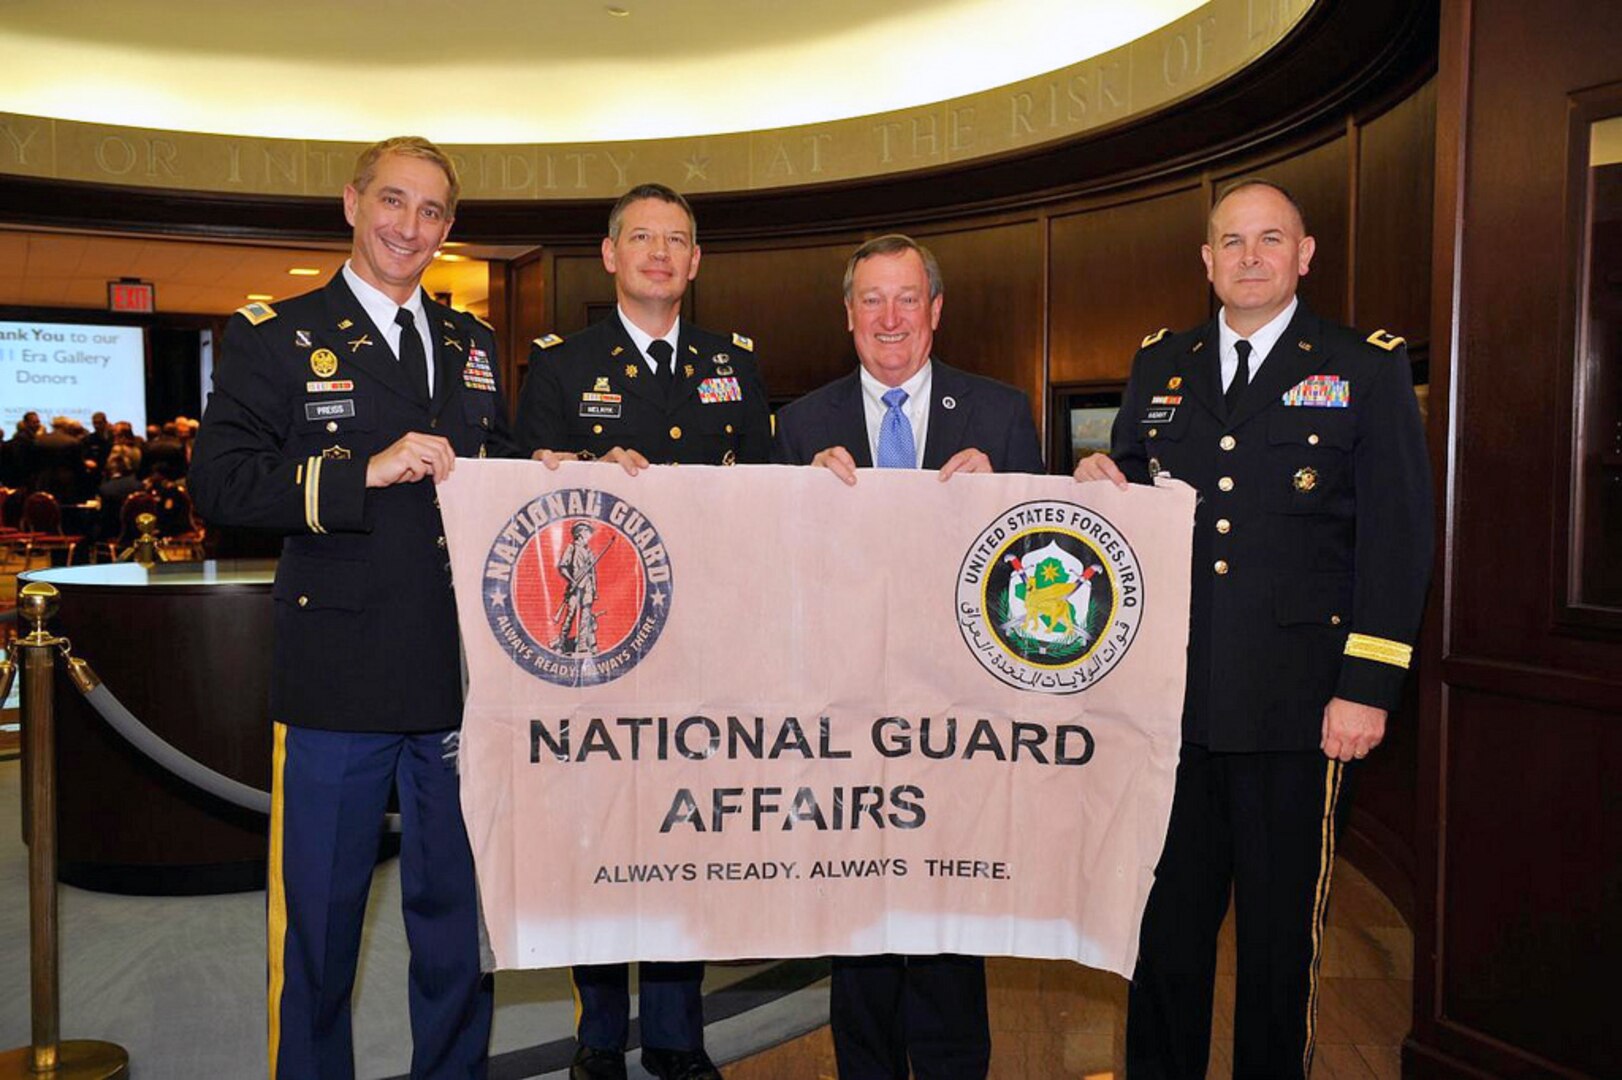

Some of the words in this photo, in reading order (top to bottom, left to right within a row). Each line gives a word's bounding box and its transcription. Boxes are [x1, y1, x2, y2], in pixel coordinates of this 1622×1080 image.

[95, 135, 180, 178] OR
[764, 133, 832, 177] AT
[873, 107, 976, 165] THE
[1009, 62, 1124, 138] RISK
[1163, 16, 1215, 87] OF
[114, 285, 148, 310] EXIT
[22, 349, 48, 363] Era
[53, 350, 111, 368] Gallery
[32, 328, 65, 342] You
[70, 332, 87, 343] to
[92, 333, 119, 344] our
[16, 369, 78, 384] Donors
[486, 491, 600, 581] NATIONAL
[609, 500, 670, 583] GUARD
[965, 528, 1005, 584] UNITED
[1007, 508, 1065, 531] STATES
[1070, 512, 1137, 608] FORCES-IRAQ
[497, 615, 533, 660] ALWAYS
[631, 615, 656, 651] THERE
[529, 715, 852, 764] NATIONAL
[871, 715, 1095, 766] GUARD
[659, 784, 926, 832] AFFAIRS
[594, 863, 698, 884] ALWAYS
[706, 861, 800, 882] READY.
[809, 858, 908, 879] ALWAYS
[924, 858, 1012, 880] THERE.
